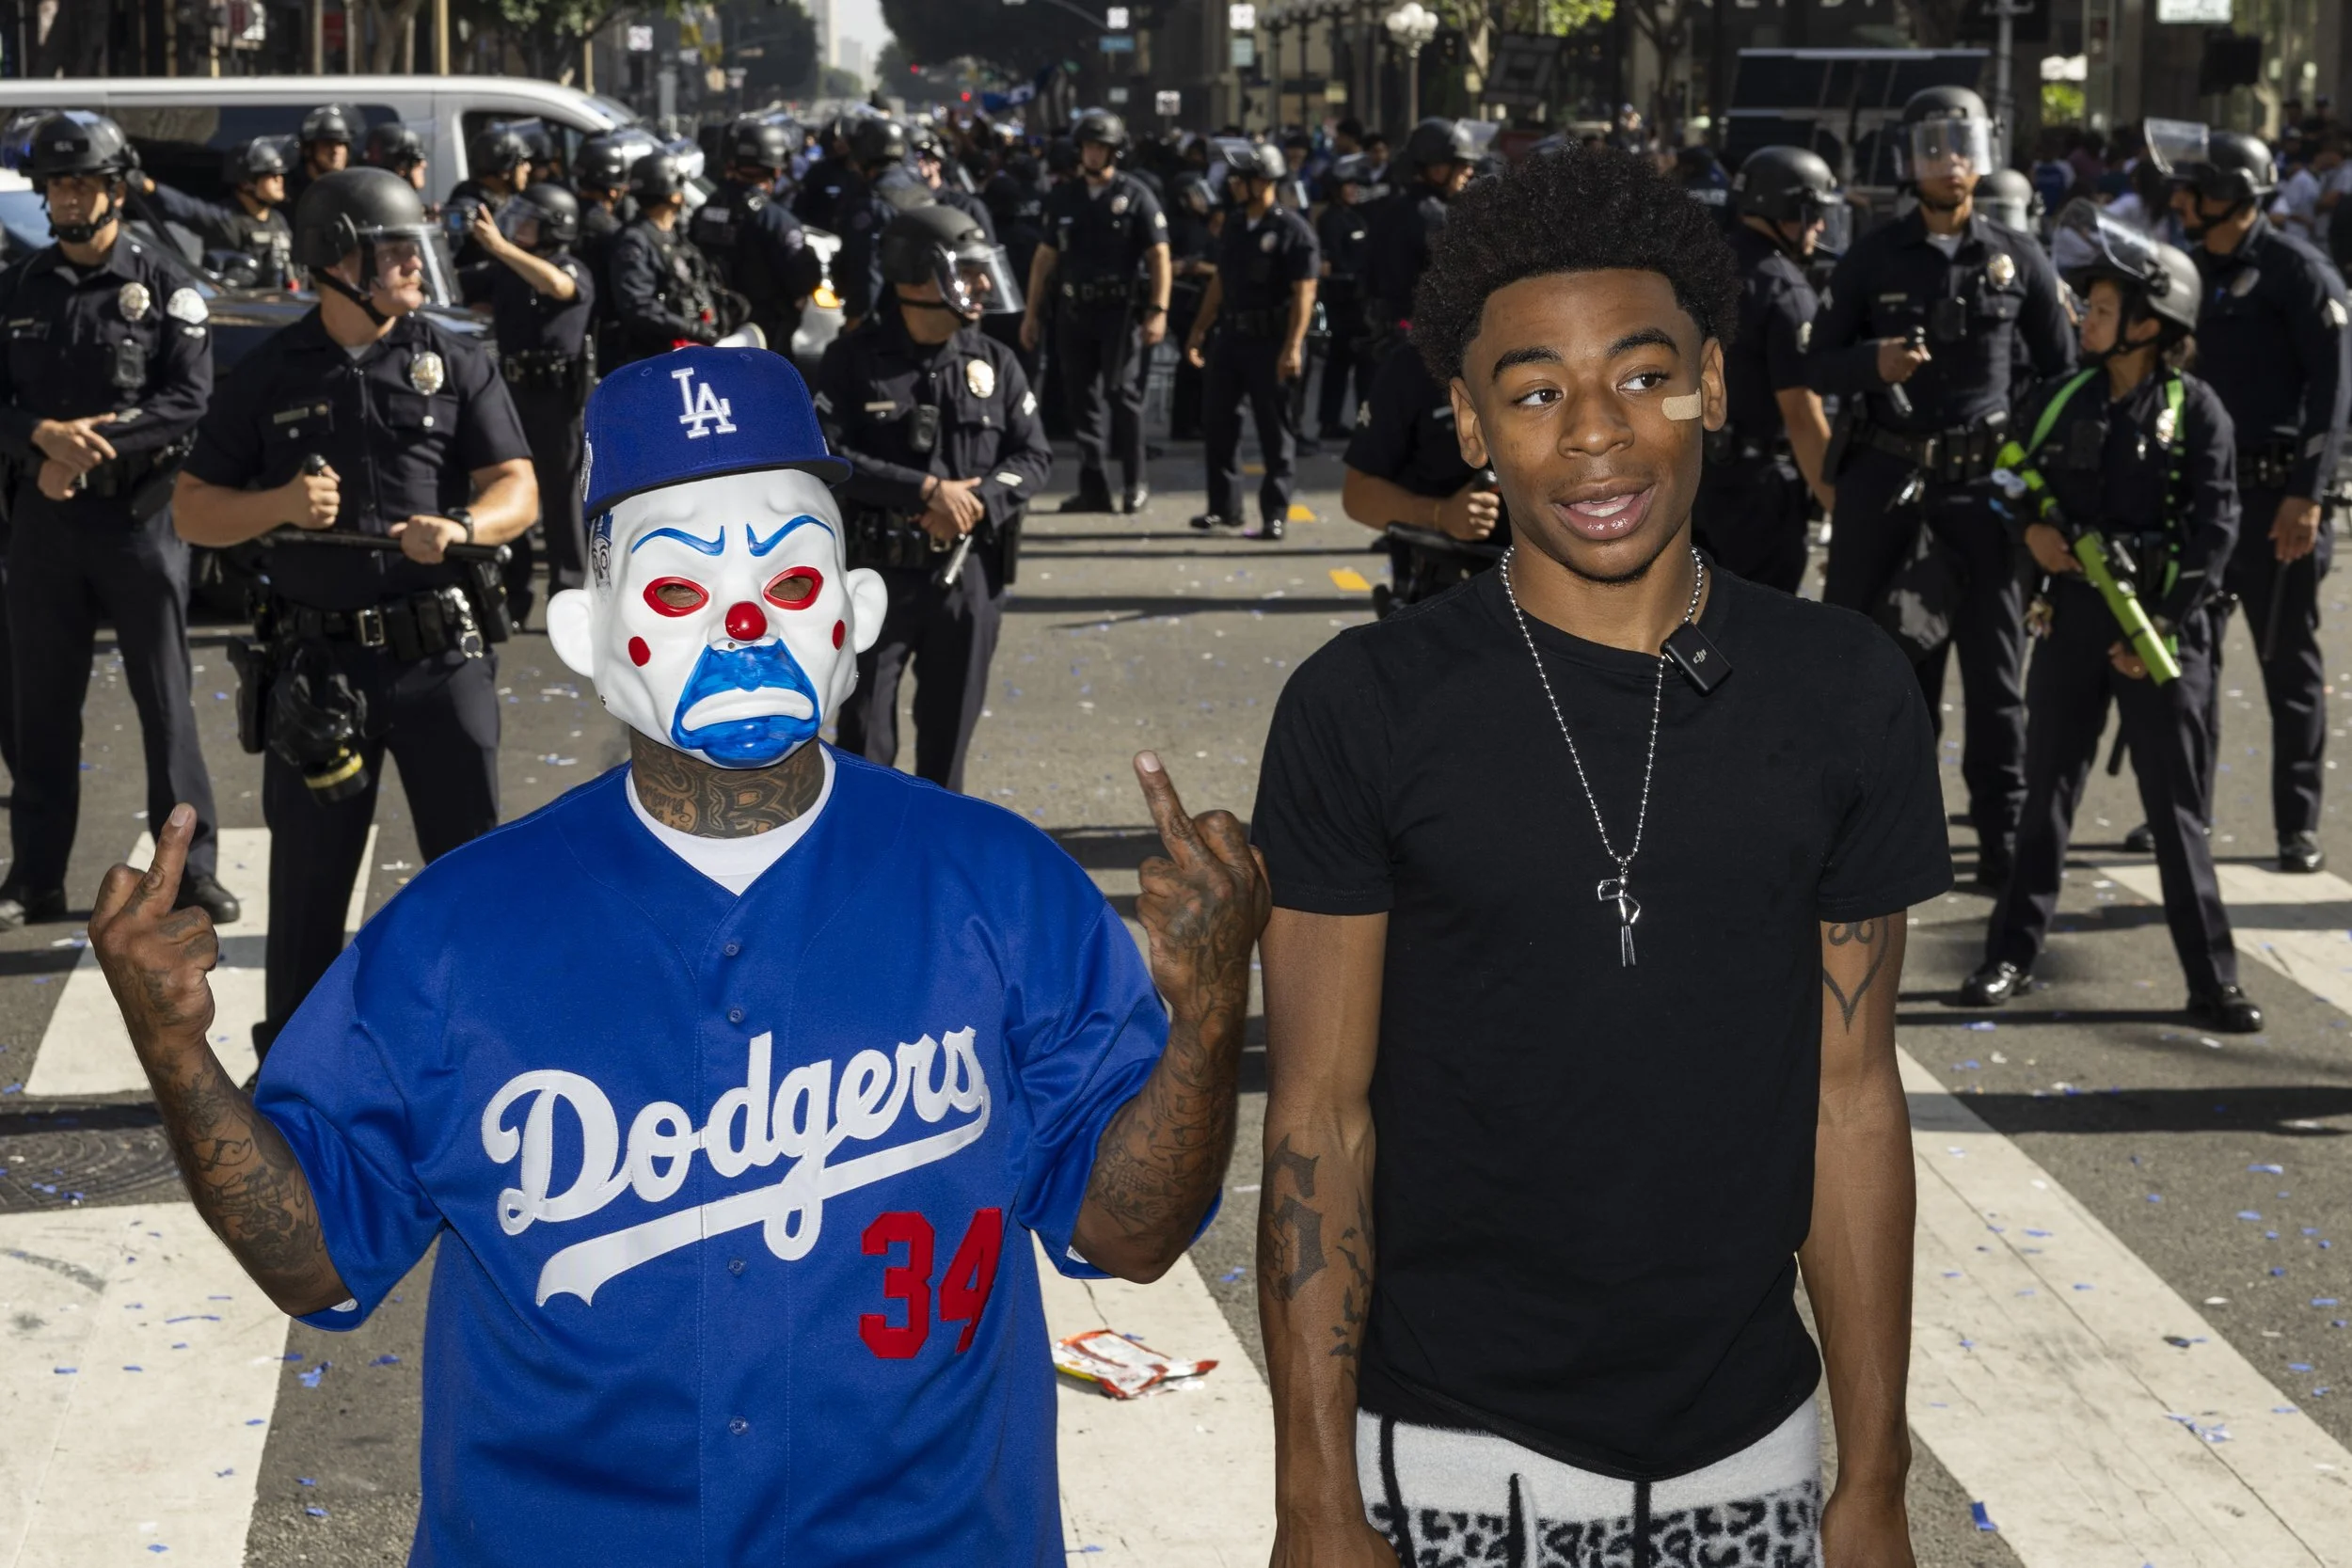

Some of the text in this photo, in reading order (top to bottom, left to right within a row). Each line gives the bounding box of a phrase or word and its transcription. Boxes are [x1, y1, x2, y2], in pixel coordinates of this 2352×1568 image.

[671, 367, 737, 439] LA
[482, 1025, 992, 1261] Dodgers
[859, 1207, 1003, 1359] 34
